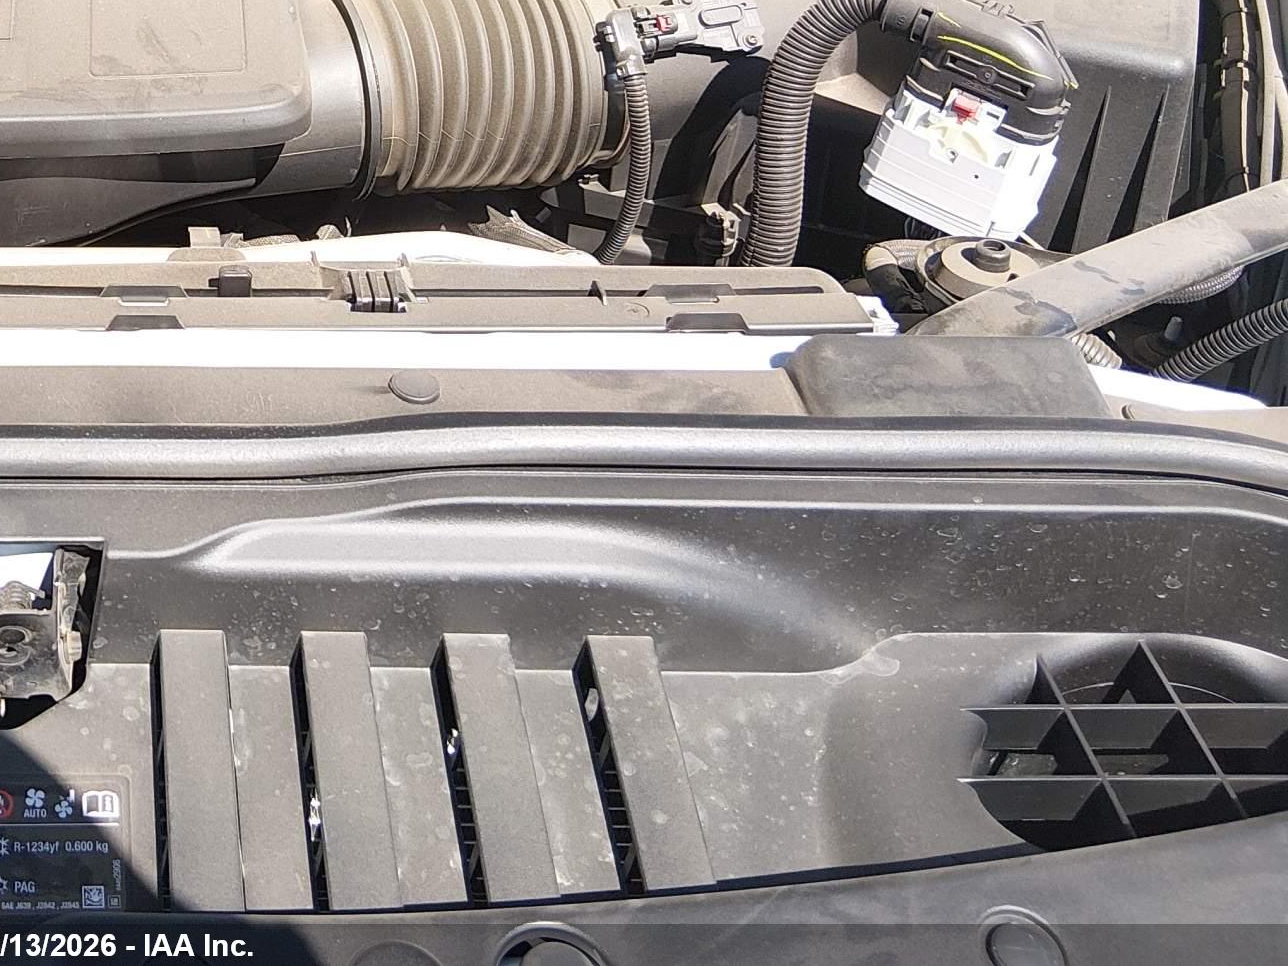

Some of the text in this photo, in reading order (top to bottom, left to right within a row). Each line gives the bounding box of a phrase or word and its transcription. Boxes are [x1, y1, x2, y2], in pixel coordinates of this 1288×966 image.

[23, 808, 47, 818] AUTO
[13, 840, 109, 854] R-1234yf 0.600 kg
[14, 881, 36, 894] PAG
